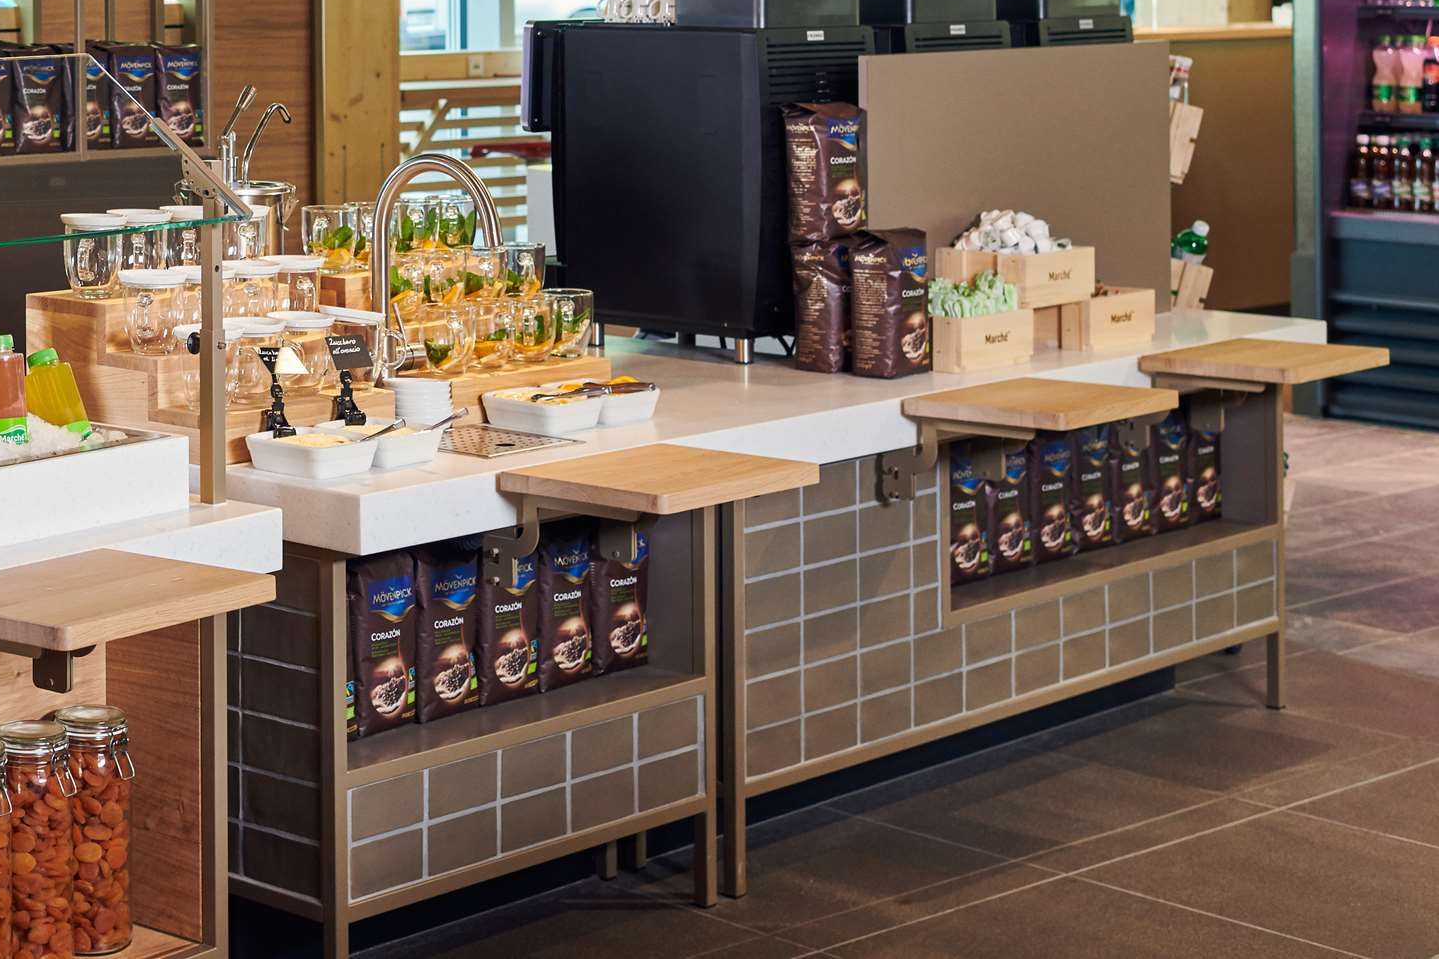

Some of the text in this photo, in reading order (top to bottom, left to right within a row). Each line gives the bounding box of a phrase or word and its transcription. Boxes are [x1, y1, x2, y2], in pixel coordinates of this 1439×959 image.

[434, 575, 477, 593] MÖVENPICK
[610, 575, 638, 588] CORAZÓN
[372, 586, 413, 605] MÖVENPICK
[553, 590, 582, 602] CORAZÓN
[495, 601, 523, 614] CORAZÓN
[433, 615, 465, 630] CORAZÓN
[371, 627, 401, 642] CORAZÓN
